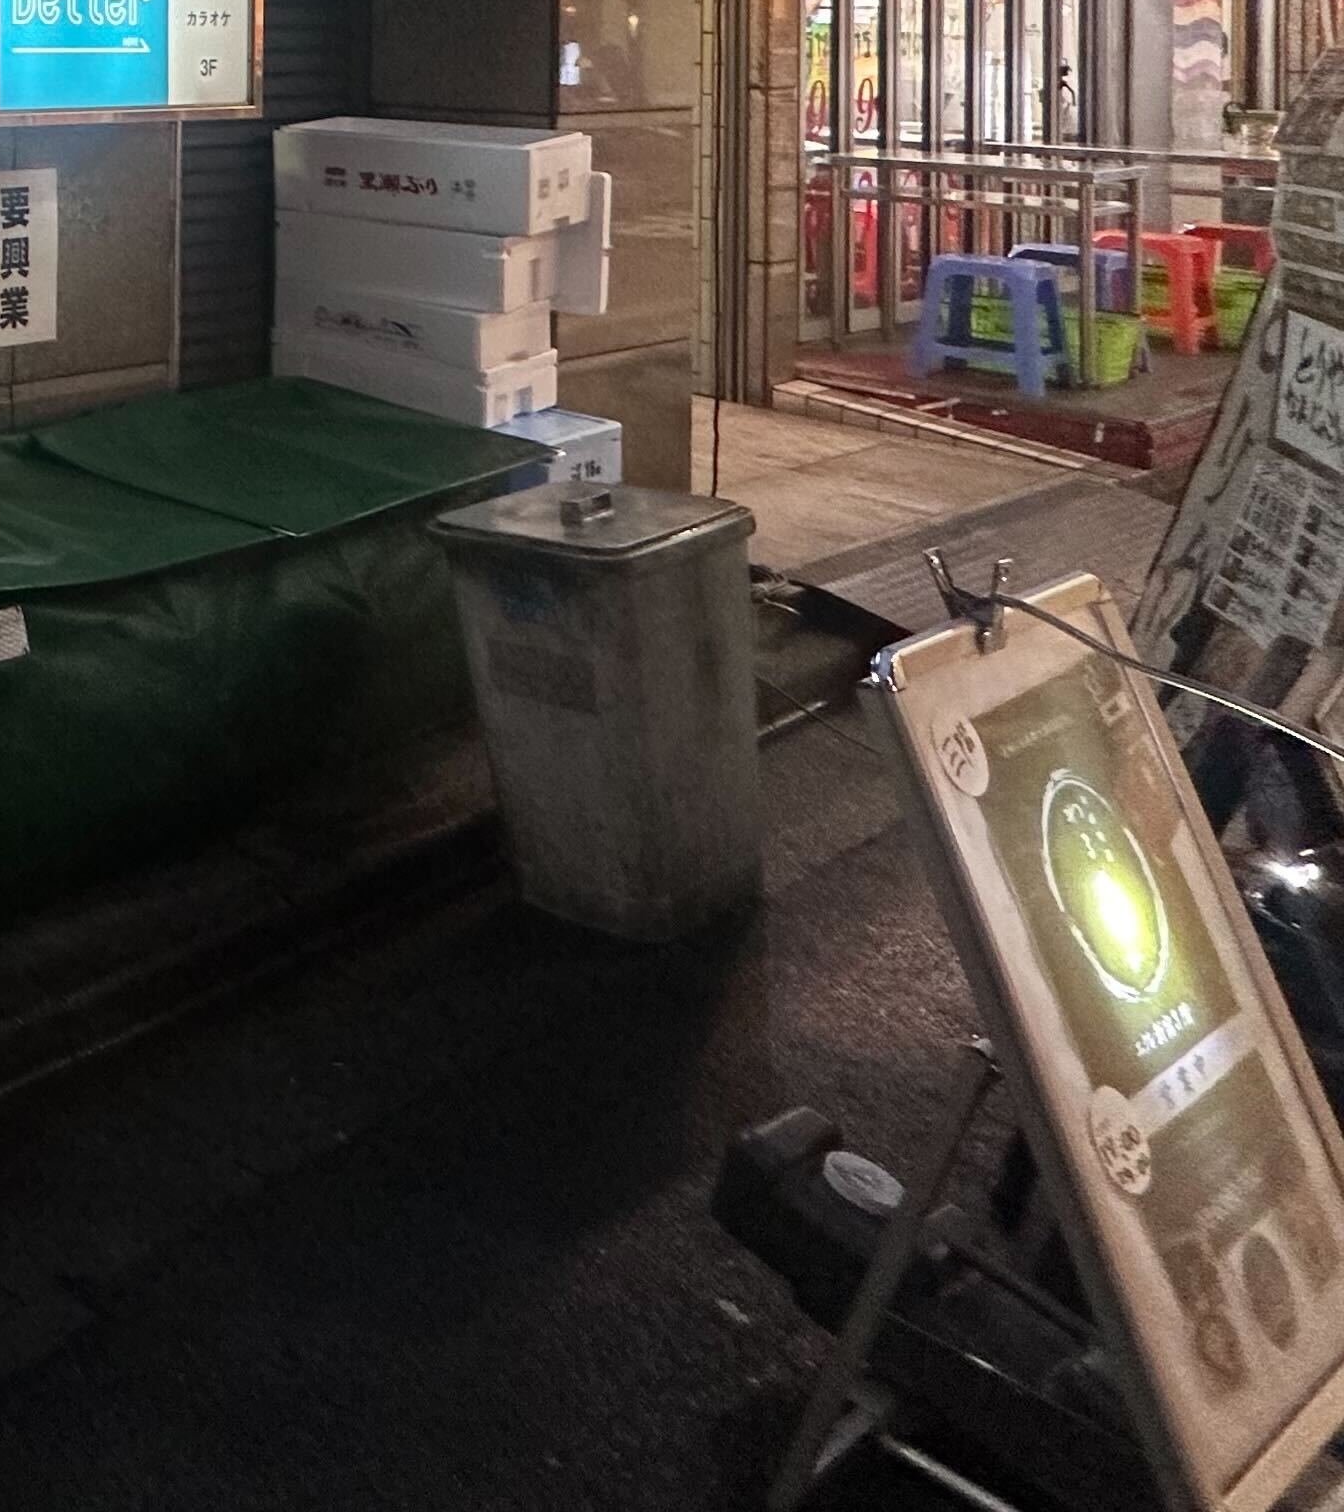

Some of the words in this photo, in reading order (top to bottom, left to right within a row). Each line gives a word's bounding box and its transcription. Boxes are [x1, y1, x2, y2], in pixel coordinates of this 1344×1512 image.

[187, 11, 231, 27] カラオケ
[200, 59, 218, 77] 3F
[0, 186, 31, 330] 要興業
